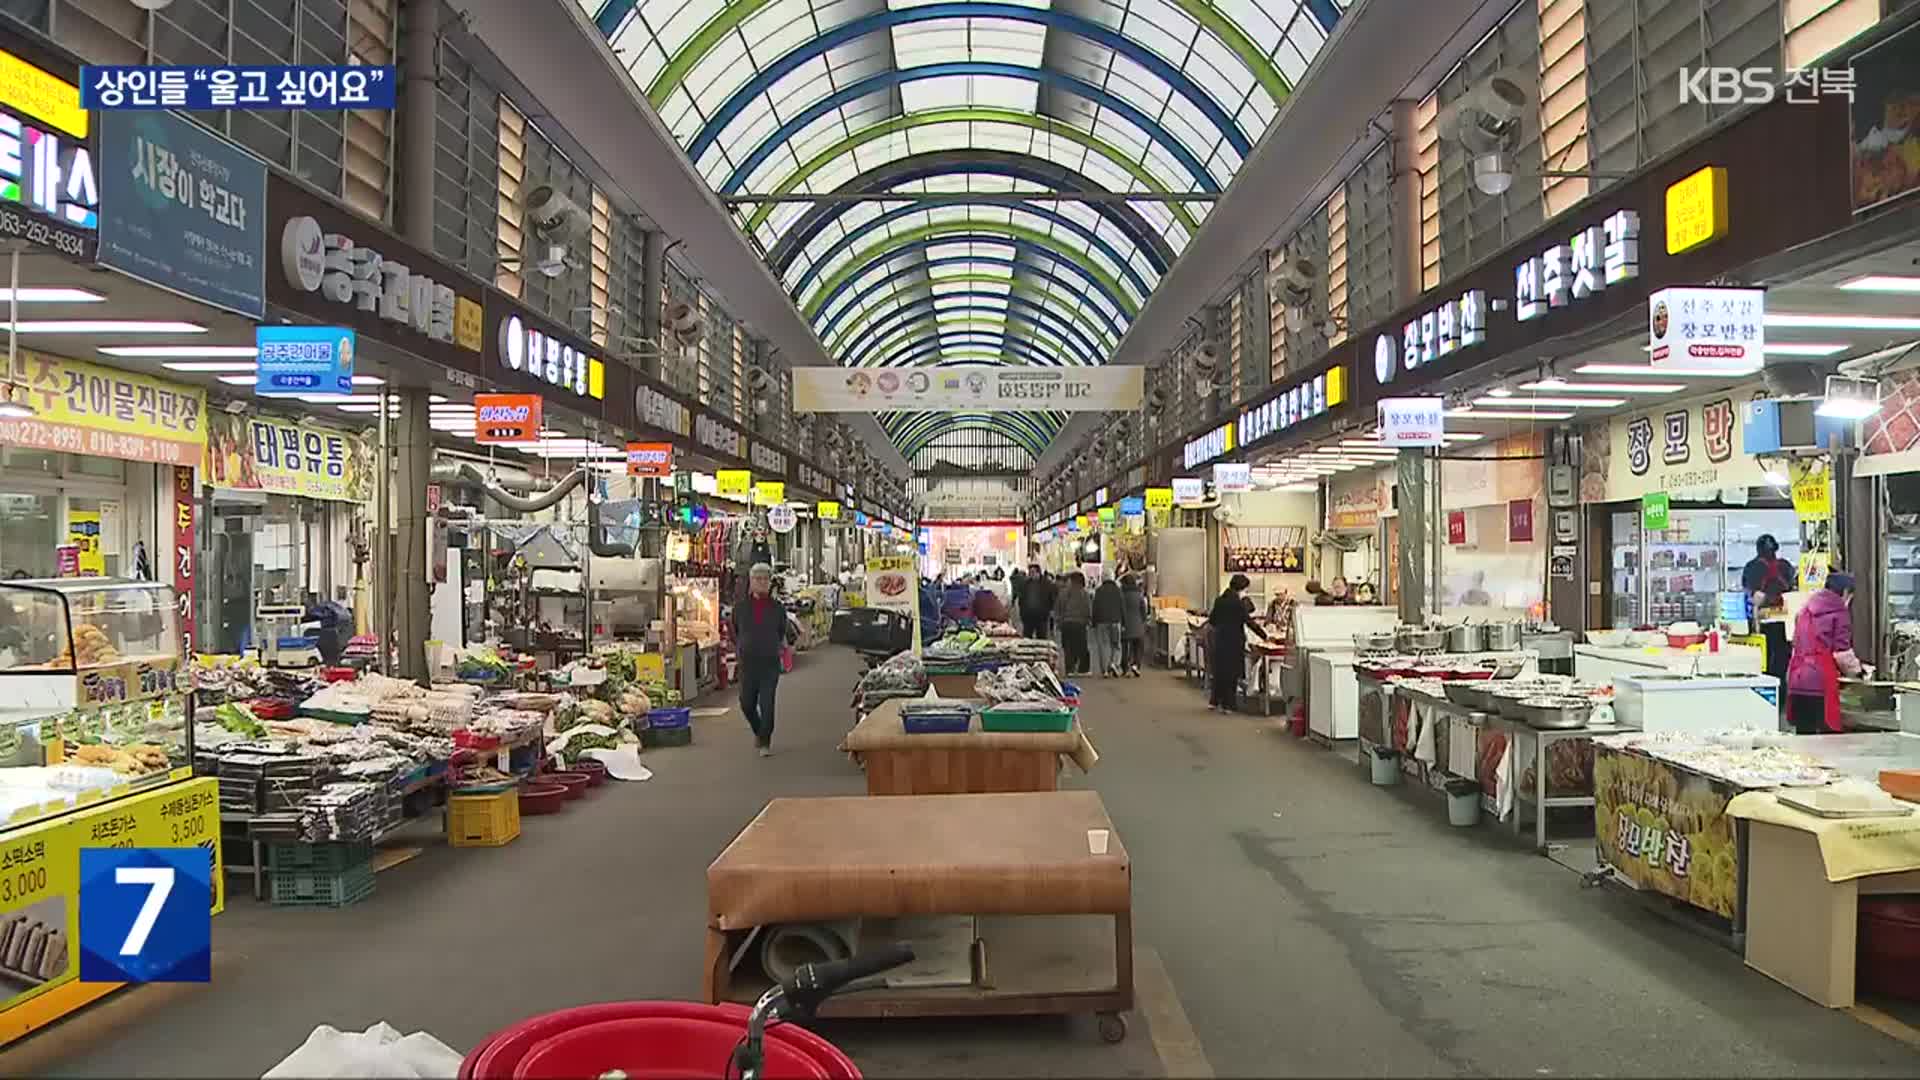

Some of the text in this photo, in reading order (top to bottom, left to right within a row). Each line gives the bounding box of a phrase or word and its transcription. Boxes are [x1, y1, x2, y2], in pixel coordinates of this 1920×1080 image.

[131, 135, 194, 208] 시장이
[200, 179, 247, 231] 학교다
[1403, 290, 1485, 370] 장모반찬
[1516, 210, 1638, 322] 전주젓갈
[1681, 321, 1757, 340] 장모반찬
[252, 422, 345, 478] 태평유통
[1618, 811, 1692, 877] 장모반찬
[1, 867, 47, 903] 3,000
